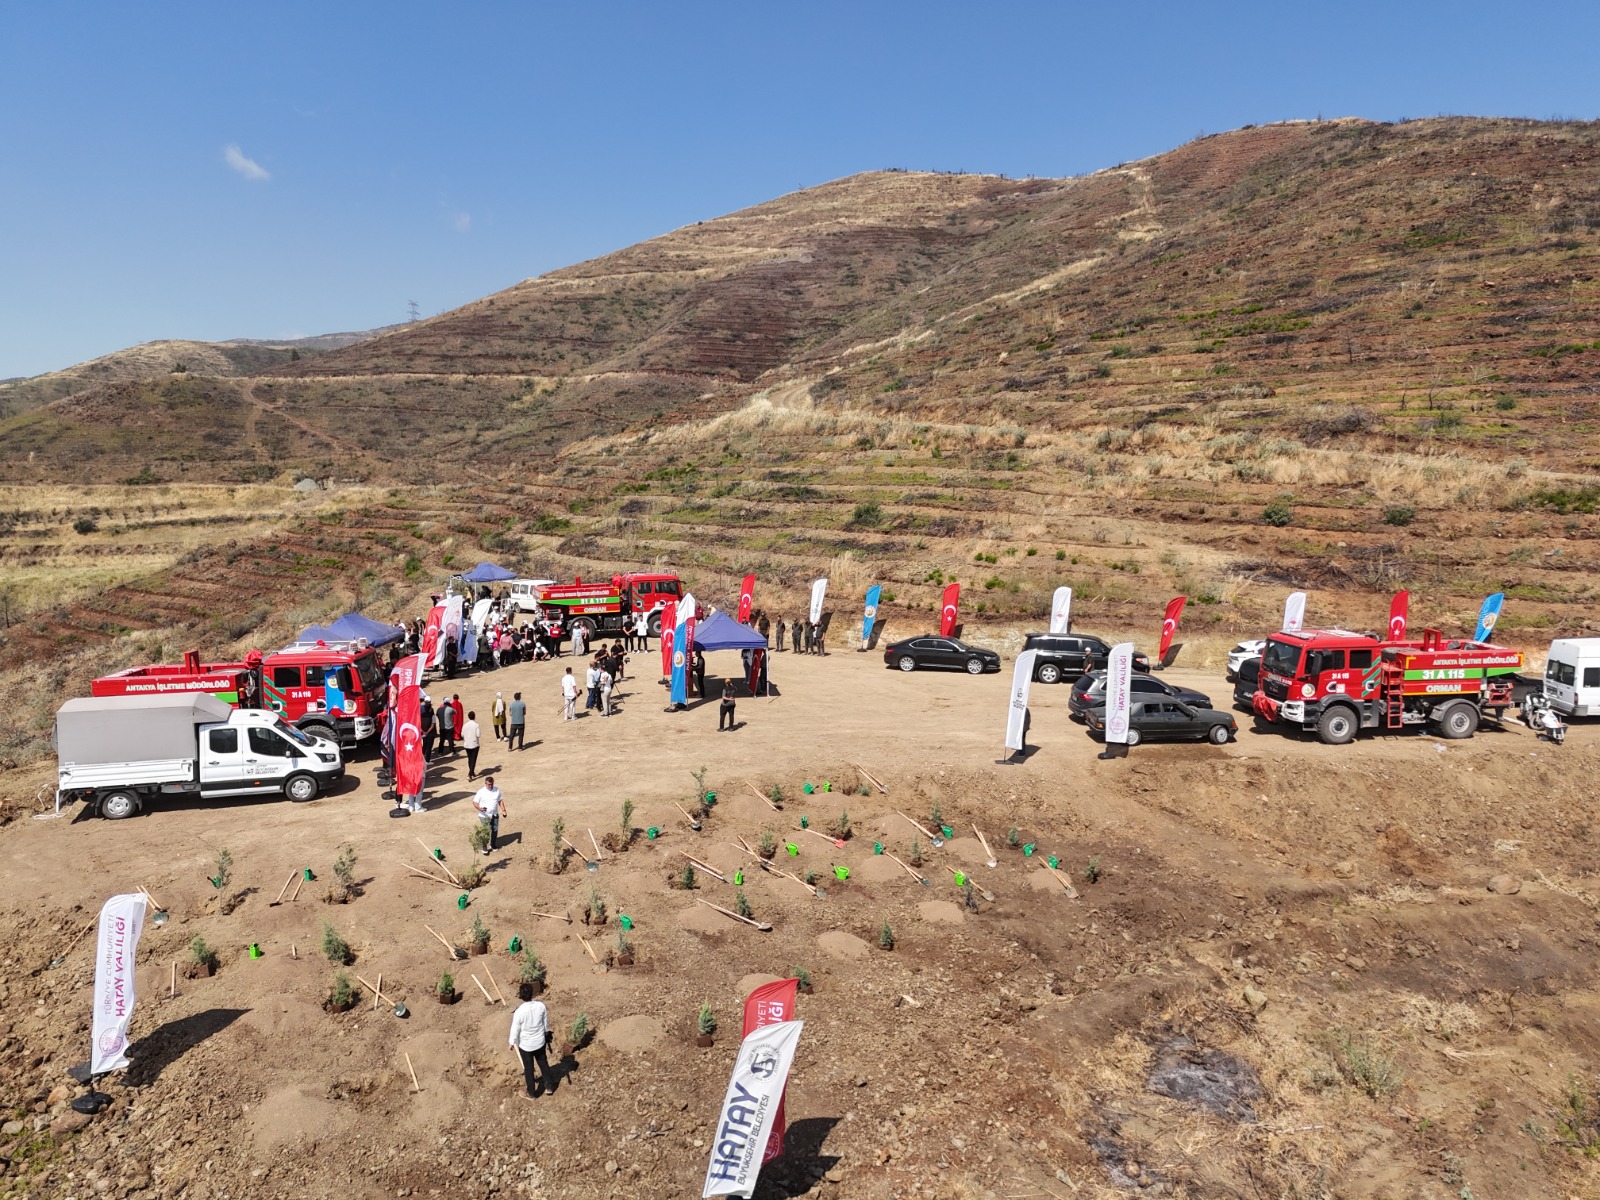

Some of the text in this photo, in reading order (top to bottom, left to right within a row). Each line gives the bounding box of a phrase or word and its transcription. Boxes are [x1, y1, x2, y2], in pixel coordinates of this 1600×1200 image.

[1458, 658, 1482, 666] İŞLETME
[1483, 656, 1519, 664] MÜDÜRLÜĞÜ
[1423, 670, 1465, 680] 31 A 115
[157, 683, 186, 691] İŞLETME
[186, 680, 230, 689] MÜDÜRLÜĞÜ
[1426, 684, 1461, 692] ORMAN
[104, 915, 115, 1015] TÜRKİYE CUMHURİYETİ
[114, 916, 126, 1017] HATAY VALİLİĞİ
[710, 1081, 759, 1182] HATAY
